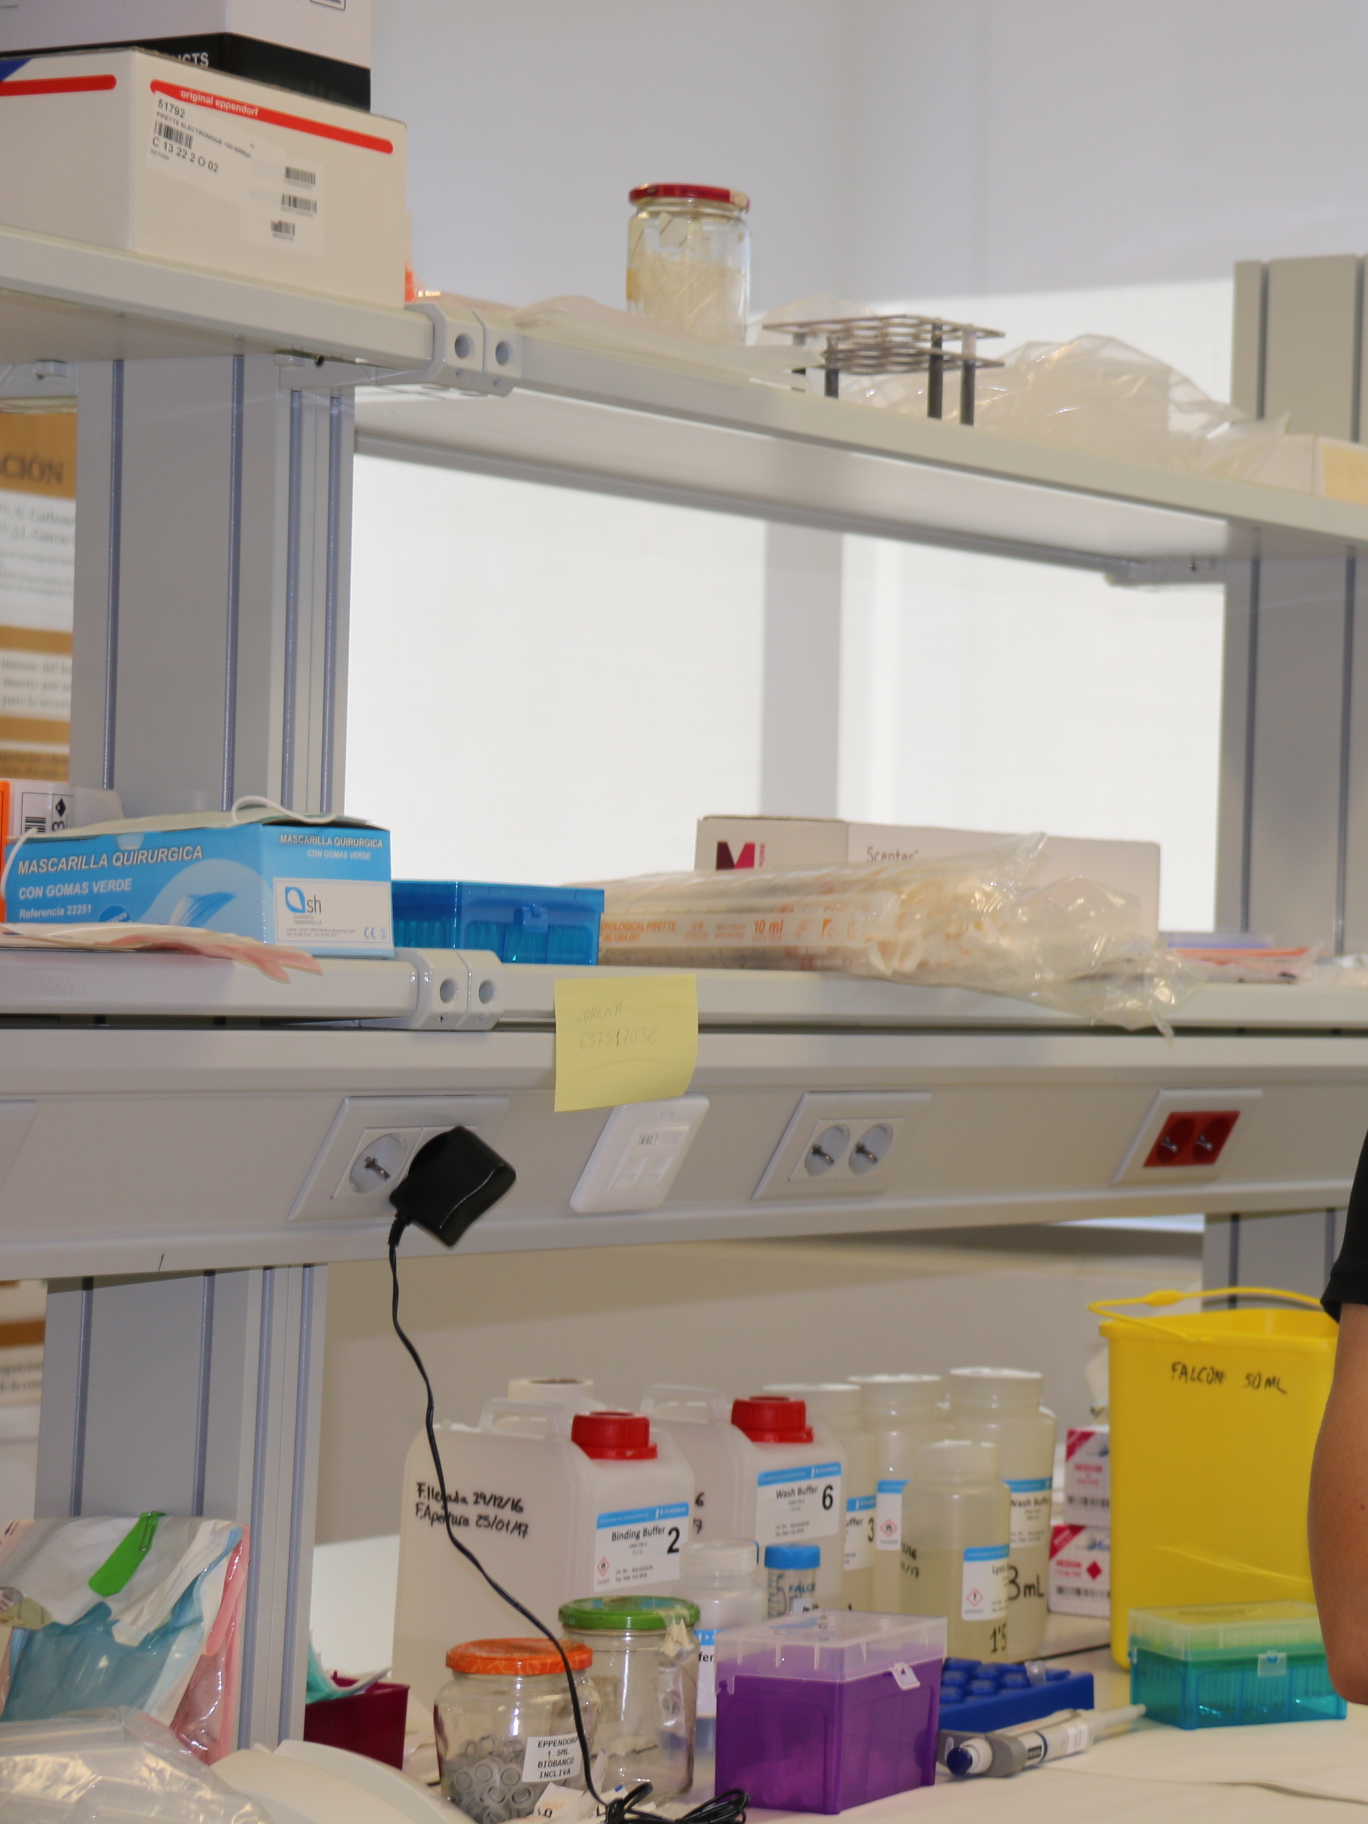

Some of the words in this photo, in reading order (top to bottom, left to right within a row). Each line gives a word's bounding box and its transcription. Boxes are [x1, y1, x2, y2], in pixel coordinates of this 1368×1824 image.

[157, 98, 186, 118] 51792
[180, 90, 214, 105] original
[215, 99, 259, 117] eppendorf
[152, 136, 160, 147] C
[163, 141, 174, 153] 13
[176, 147, 188, 159] 22
[189, 152, 196, 163] 2
[207, 160, 219, 173] 02
[280, 834, 333, 846] MASCARILLA
[334, 837, 383, 848] QUIRURGICA
[18, 853, 109, 875] MASCARILLA
[112, 845, 204, 867] QUIRURGICA
[307, 849, 322, 858] CON
[323, 850, 348, 859] GOMAS
[349, 851, 371, 860] VERDE
[19, 886, 43, 900] CON
[46, 882, 89, 897] GOMAS
[92, 878, 133, 893] VERDE
[19, 907, 65, 919] Referencia
[67, 904, 92, 916] 22251
[754, 919, 766, 933] 10
[768, 918, 784, 933] ml
[1171, 1361, 1225, 1385] FALCON
[775, 1485, 796, 1499] Wash
[797, 1485, 818, 1496] Buffer
[822, 1484, 834, 1510] 6
[611, 1528, 641, 1542] Binding
[642, 1525, 666, 1537] Buffer
[666, 1526, 680, 1554] 2
[867, 1516, 875, 1543] 3
[537, 1736, 580, 1748] EPPENDORF
[537, 1757, 575, 1768] BIOBANCO
[539, 1767, 571, 1778] INCLIVA
